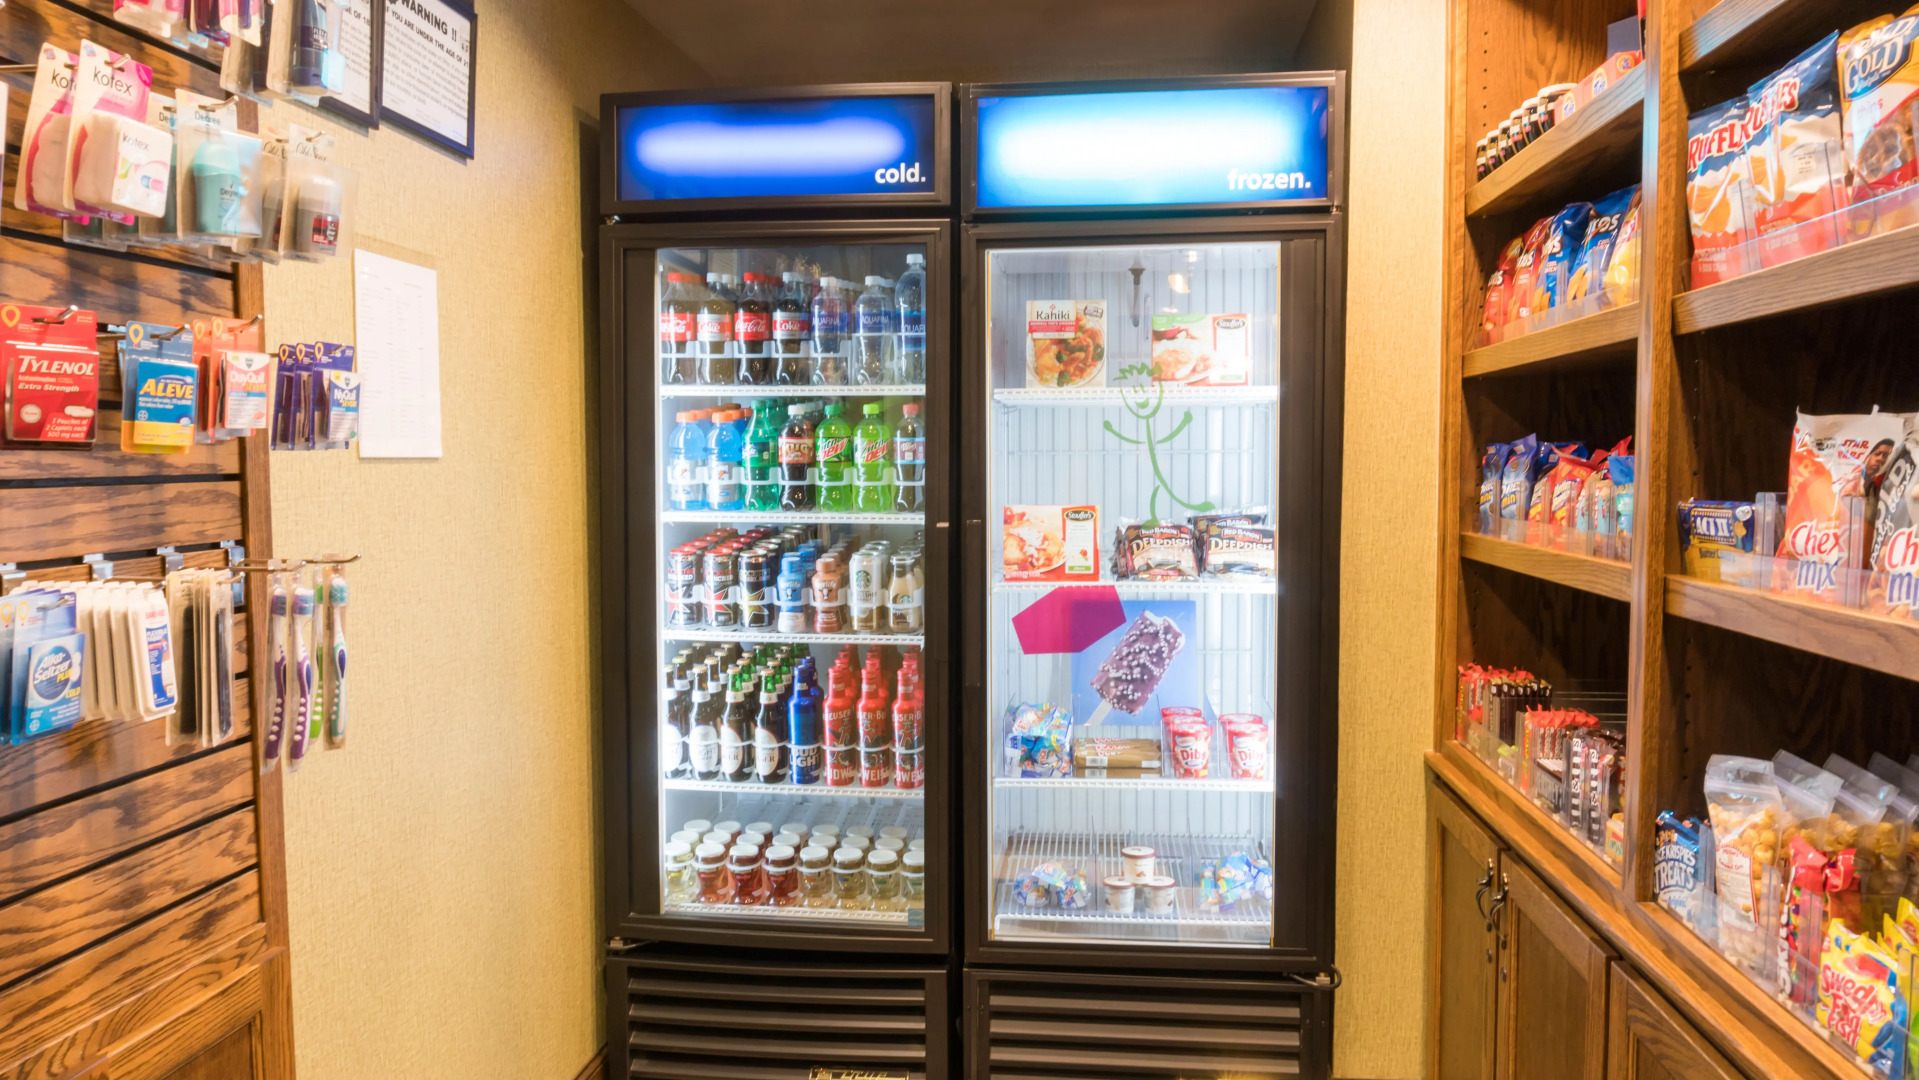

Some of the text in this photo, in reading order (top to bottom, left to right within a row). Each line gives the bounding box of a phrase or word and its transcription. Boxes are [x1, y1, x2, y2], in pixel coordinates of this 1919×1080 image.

[401, 0, 448, 36] WARNING
[392, 9, 404, 23] YOU
[404, 19, 415, 32] ARE
[415, 26, 434, 44] UNDER
[435, 39, 445, 52] THE
[446, 48, 456, 59] AGE
[1845, 35, 1903, 95] GOLD
[874, 163, 926, 184] cold.
[1227, 169, 1311, 191] frozen.
[1036, 310, 1071, 320] Kahiki
[18, 355, 95, 376] TYLENOL
[18, 382, 80, 393] Extra Strength
[139, 378, 194, 399] ALEVE
[1841, 439, 1869, 449] STAR
[1223, 528, 1260, 540] RED BARON
[1180, 748, 1206, 762] Dibs
[1653, 860, 1695, 894] TREATS
